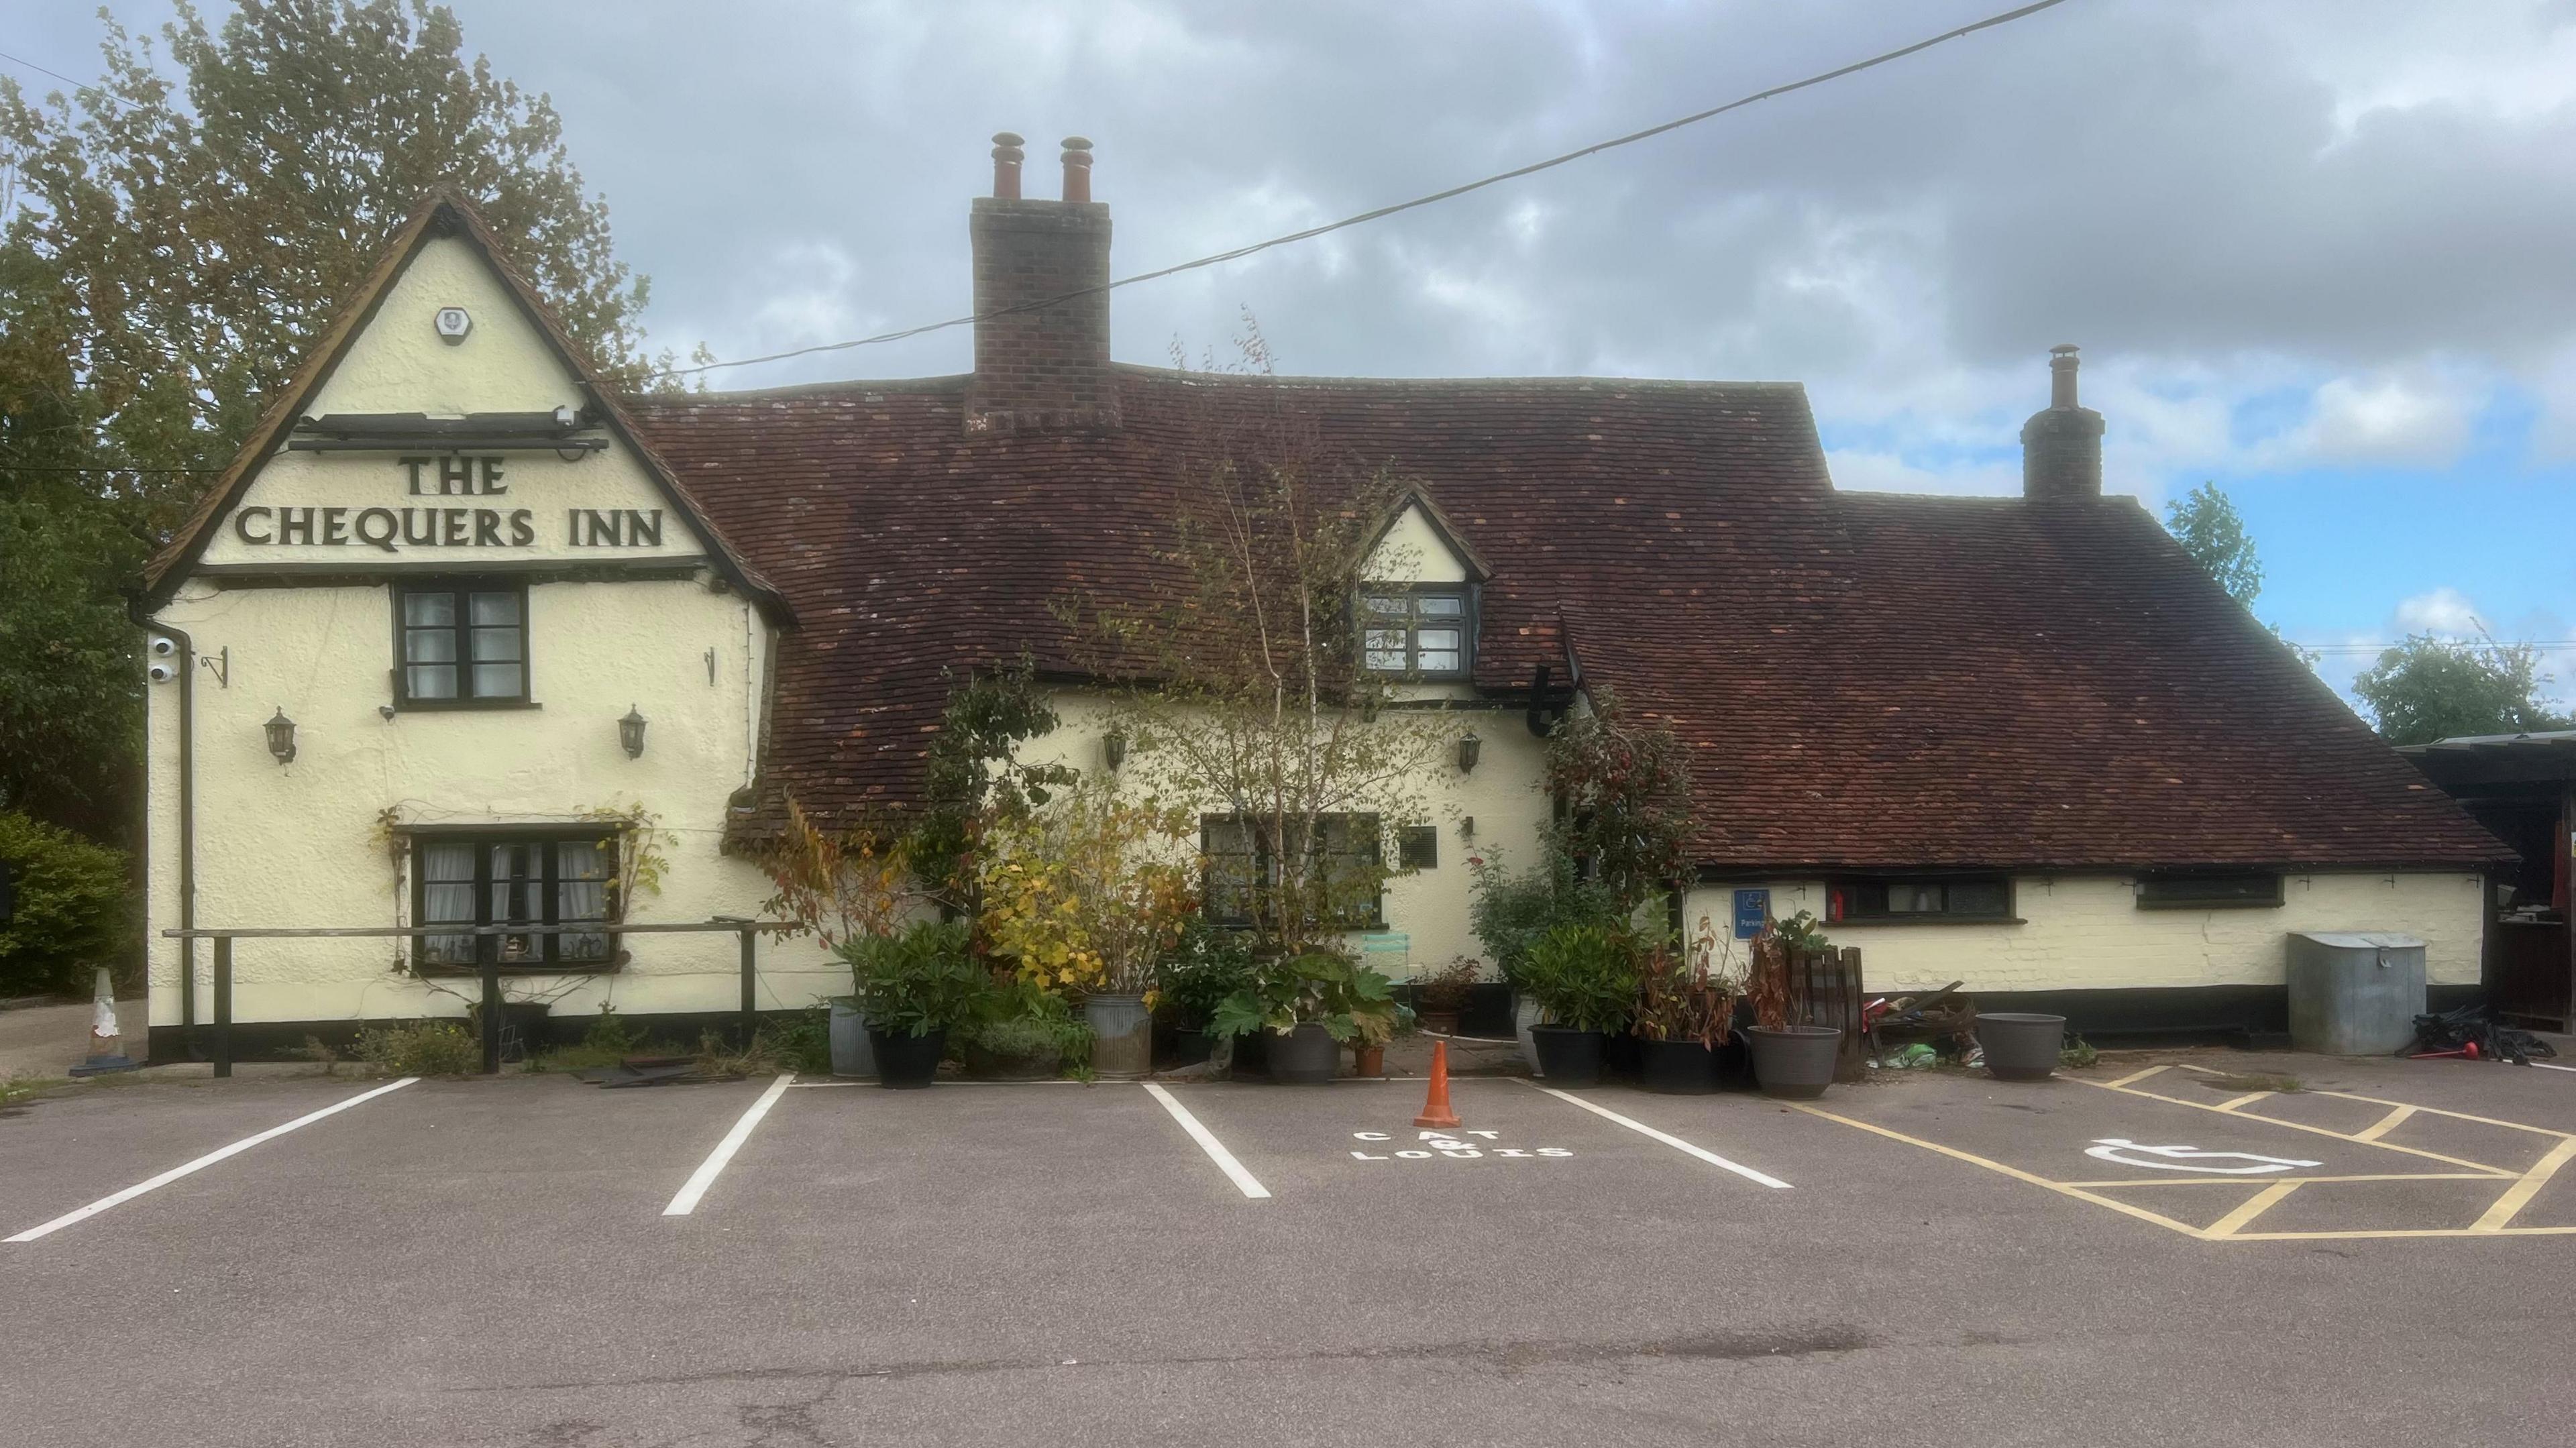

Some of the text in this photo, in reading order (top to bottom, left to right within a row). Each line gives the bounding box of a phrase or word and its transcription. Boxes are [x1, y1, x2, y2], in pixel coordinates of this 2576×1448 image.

[398, 456, 508, 495] THE
[235, 506, 662, 552] CHEQUERS INN
[1350, 1148, 1574, 1160] LOUIS
[1428, 1140, 1479, 1150] &
